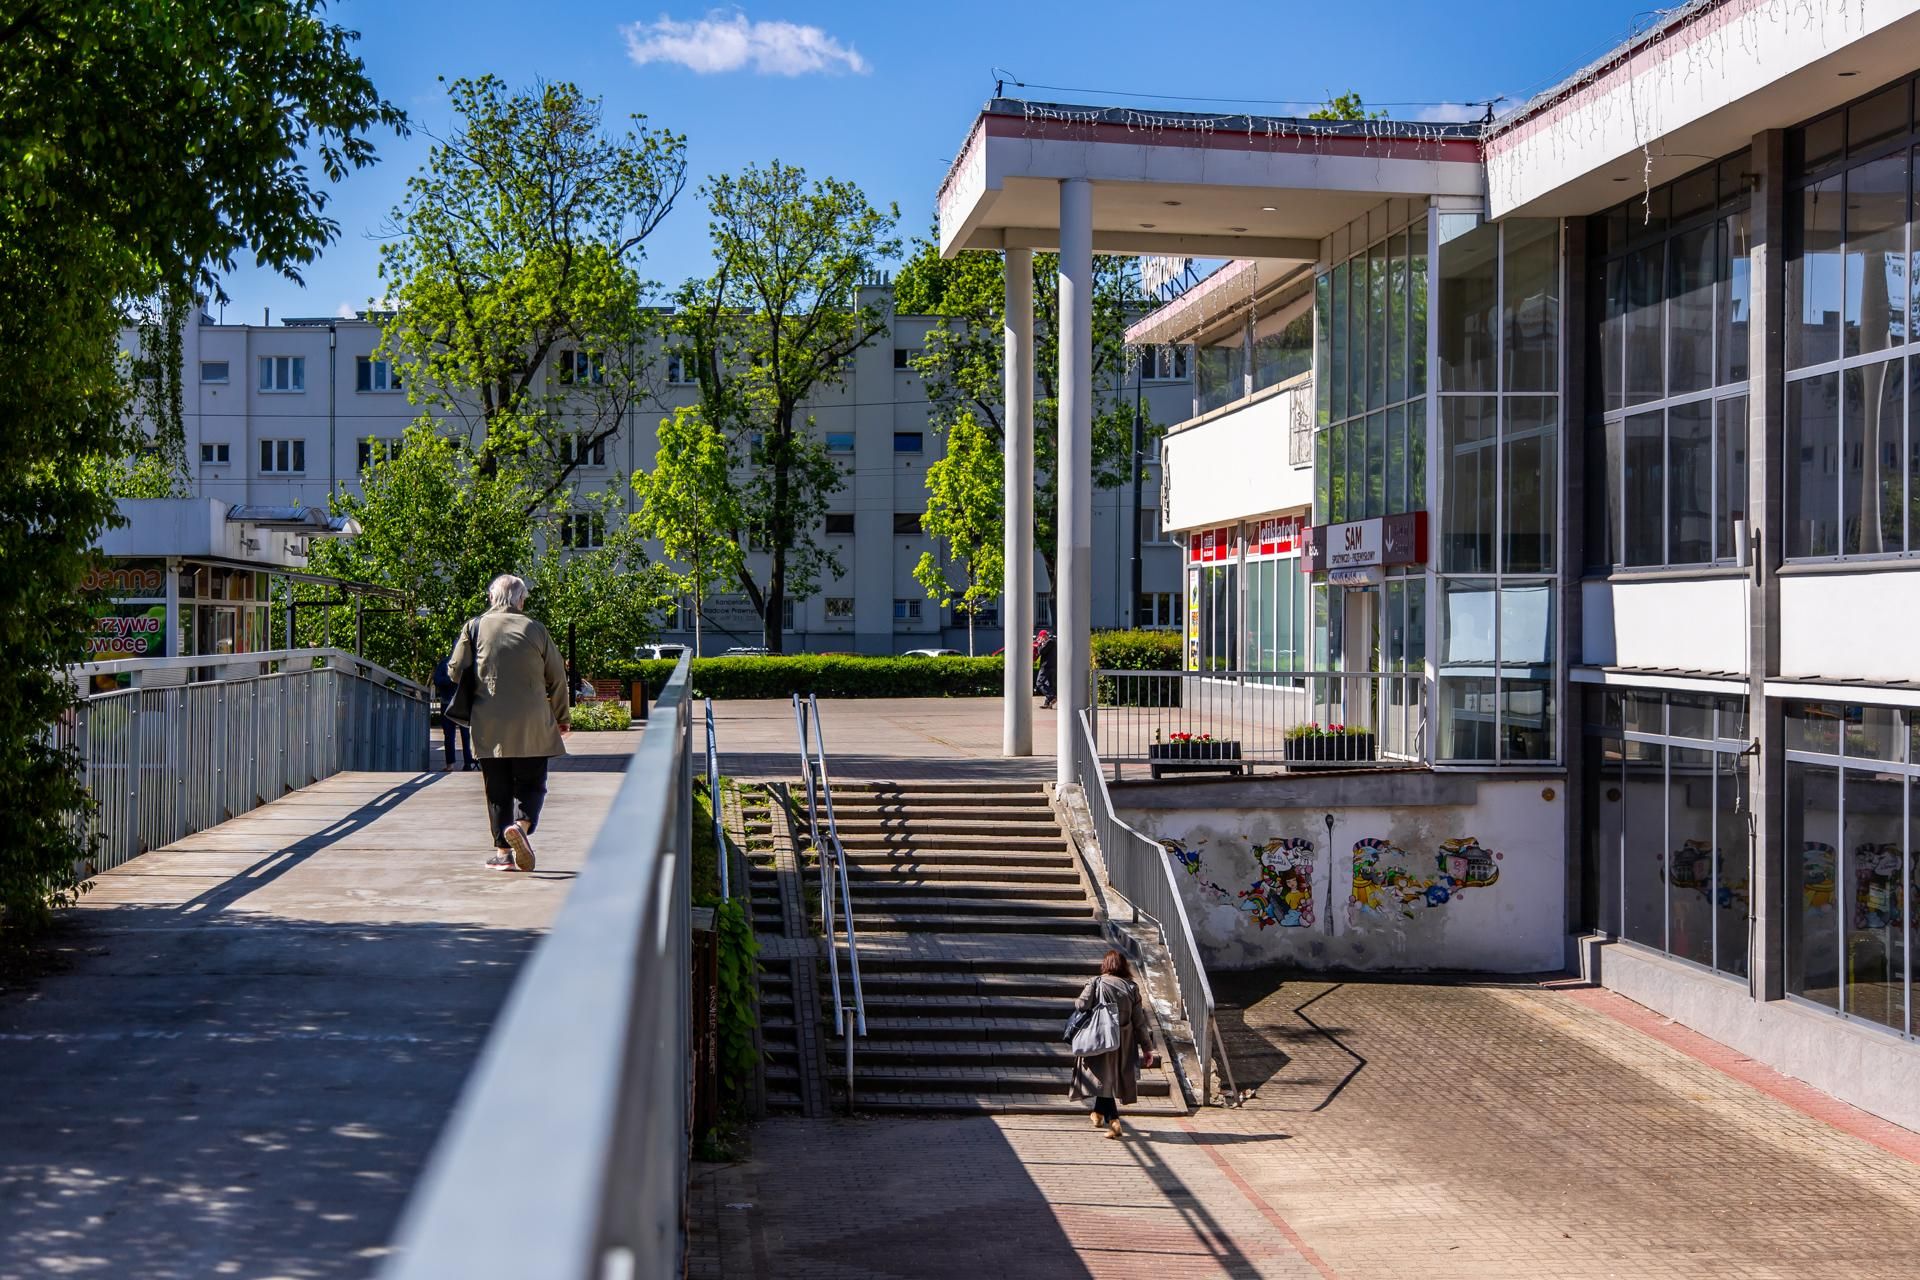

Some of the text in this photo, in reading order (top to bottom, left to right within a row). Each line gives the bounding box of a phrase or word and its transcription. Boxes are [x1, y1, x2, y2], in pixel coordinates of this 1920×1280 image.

[1345, 526, 1362, 551] SAM
[80, 568, 161, 591] oanna
[732, 607, 758, 615] Prawnyc
[78, 616, 159, 637] rzywa
[80, 636, 148, 654] owoce
